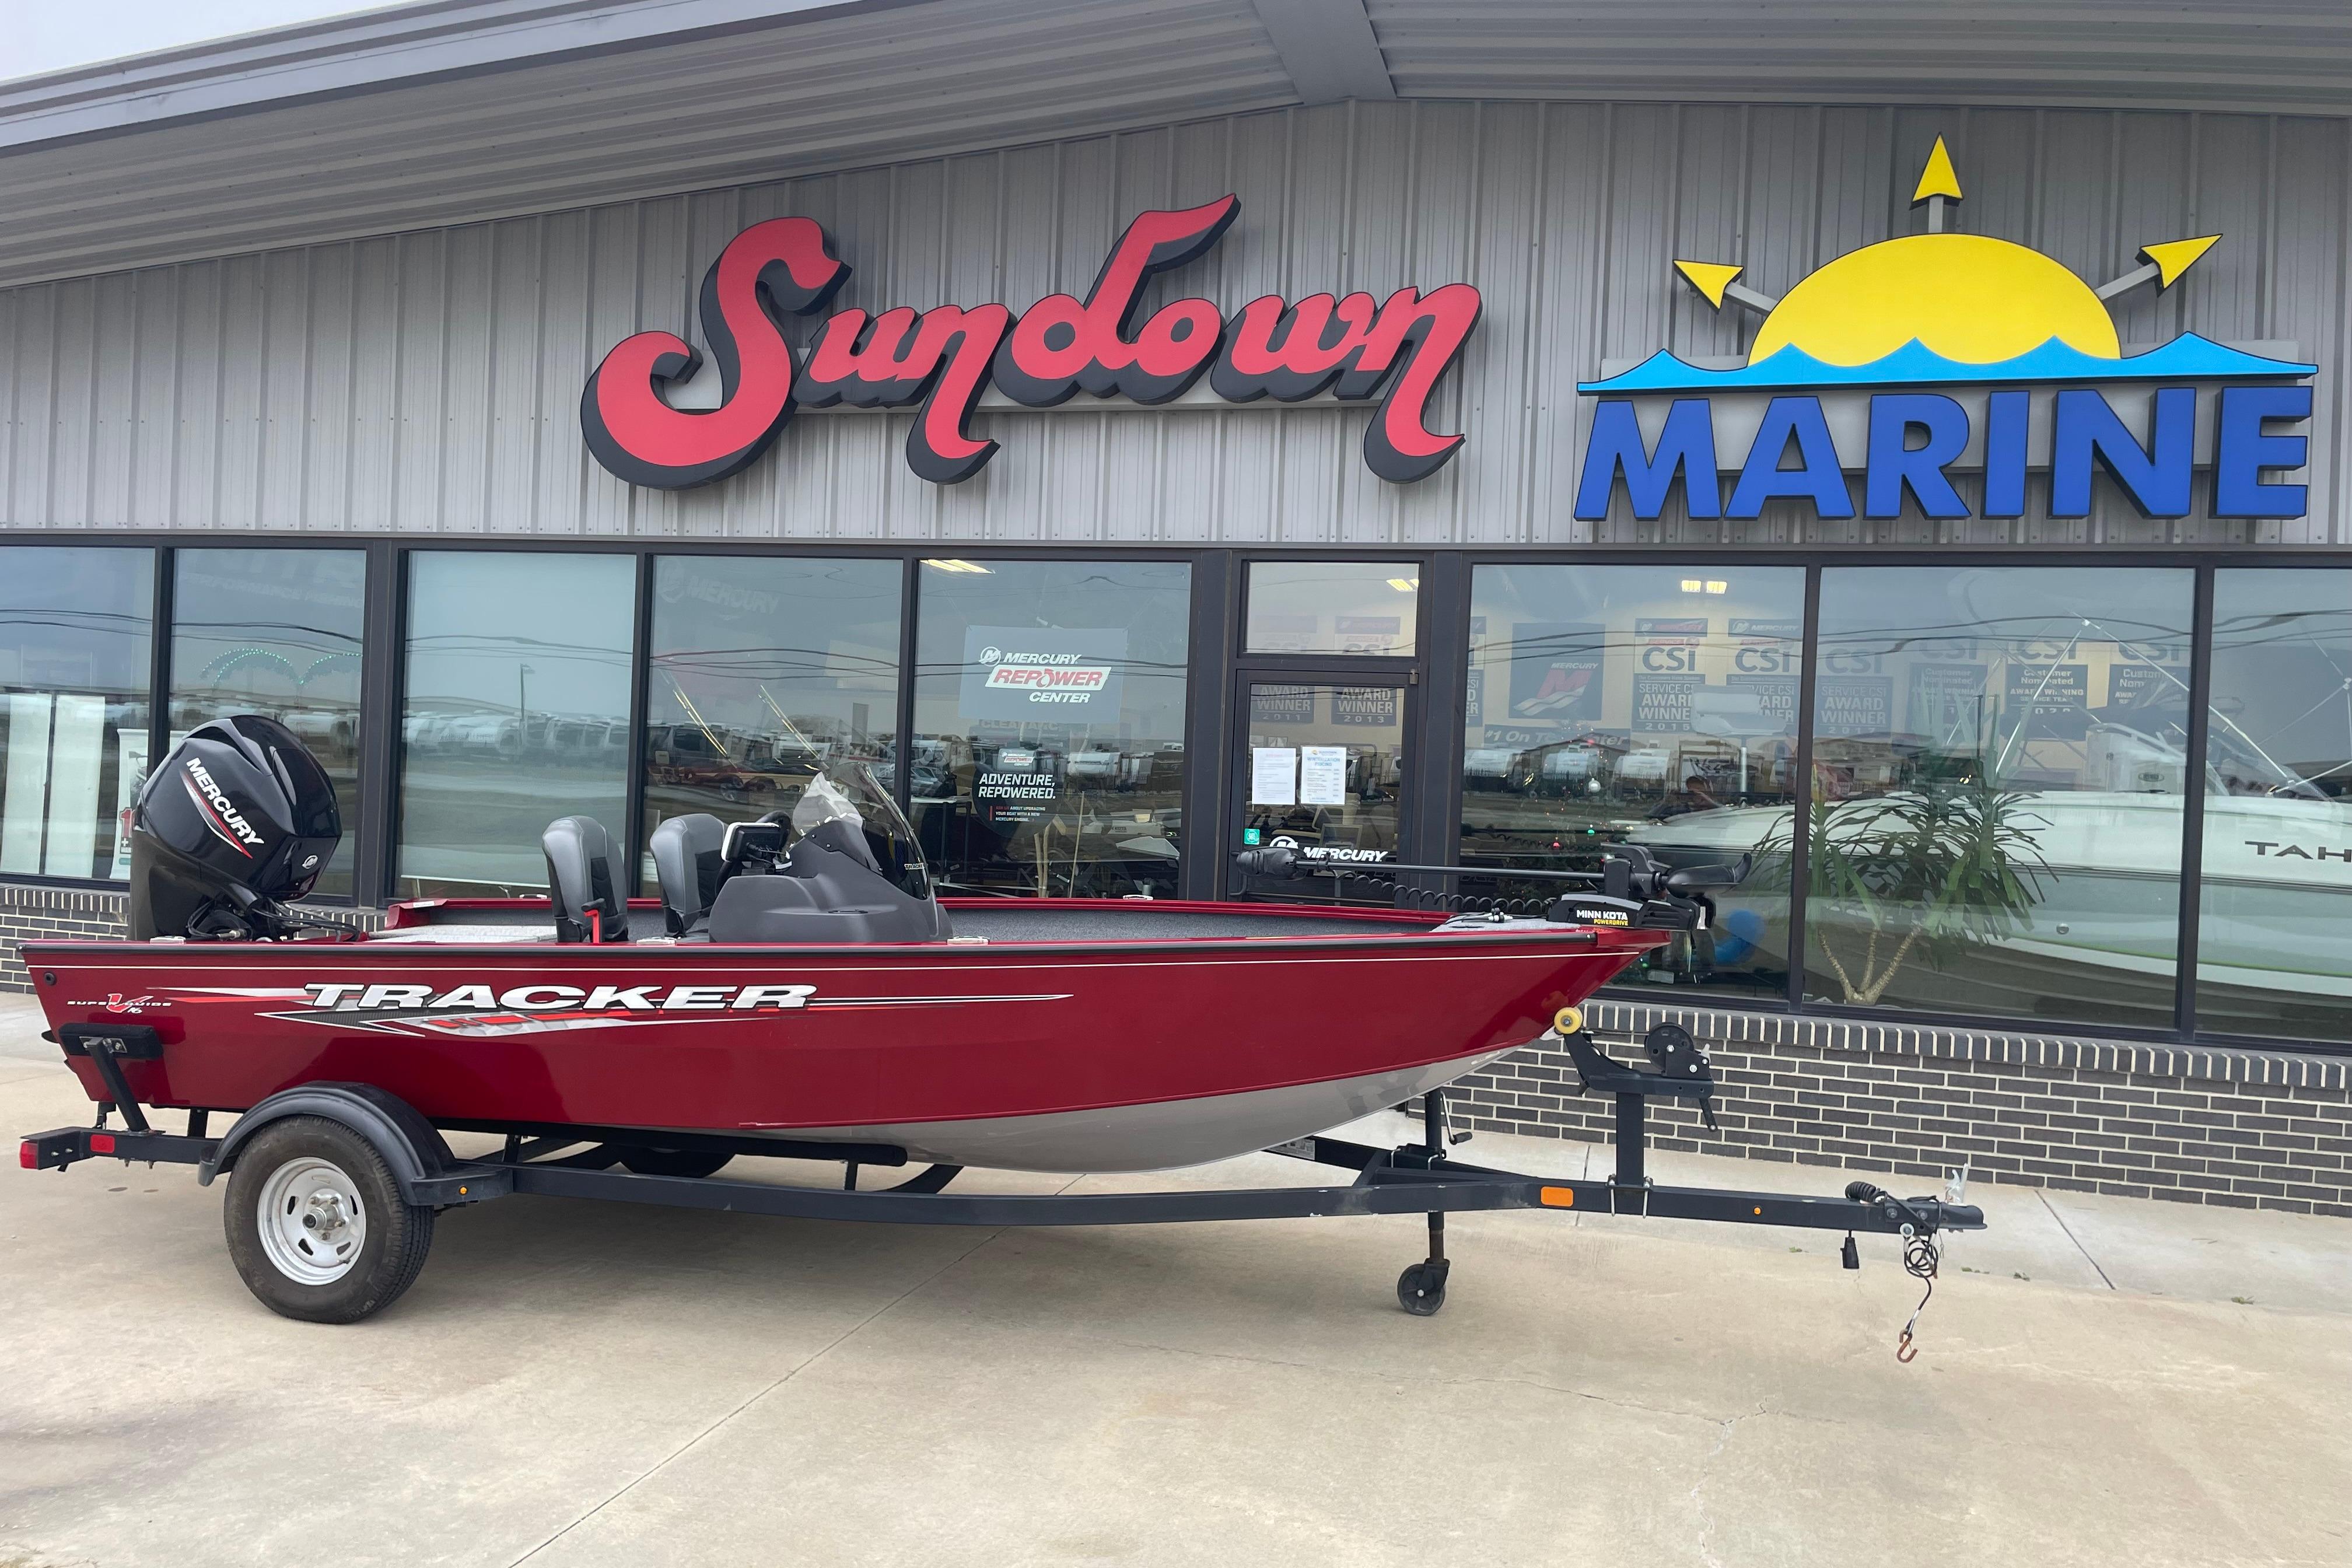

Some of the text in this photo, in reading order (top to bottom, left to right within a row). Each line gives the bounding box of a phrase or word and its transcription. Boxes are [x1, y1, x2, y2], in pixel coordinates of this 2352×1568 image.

[581, 194, 1482, 485] Sundown
[1574, 386, 2314, 521] MARINE
[1003, 652, 1083, 664] MERCURY
[993, 668, 1102, 688] REPOWER
[2021, 677, 2074, 685] Nomated
[1260, 686, 1308, 699] AWARD
[1340, 688, 1391, 701] AWARD
[1639, 684, 1681, 694] SERVICE
[1777, 685, 1795, 696] CSI
[1821, 685, 1887, 697] SERVICE CSI
[1028, 692, 1091, 704] CENTER
[1759, 695, 1792, 709] ARD
[1824, 696, 1884, 710] AWARD
[1256, 699, 1311, 712] WINNER
[1337, 701, 1394, 714] WINNER
[1638, 707, 1690, 720] WINNE
[1820, 710, 1887, 724] WINNER
[1485, 729, 1502, 741] #1
[1506, 730, 1531, 743] On
[978, 773, 1056, 788] ADVENTURE,
[978, 786, 1056, 800] REPOWERED.
[186, 757, 264, 845] MERCURY
[1303, 846, 1388, 862] MERCURY
[1576, 909, 1628, 920] MINN KOTA
[304, 983, 818, 1010] TRACKER
